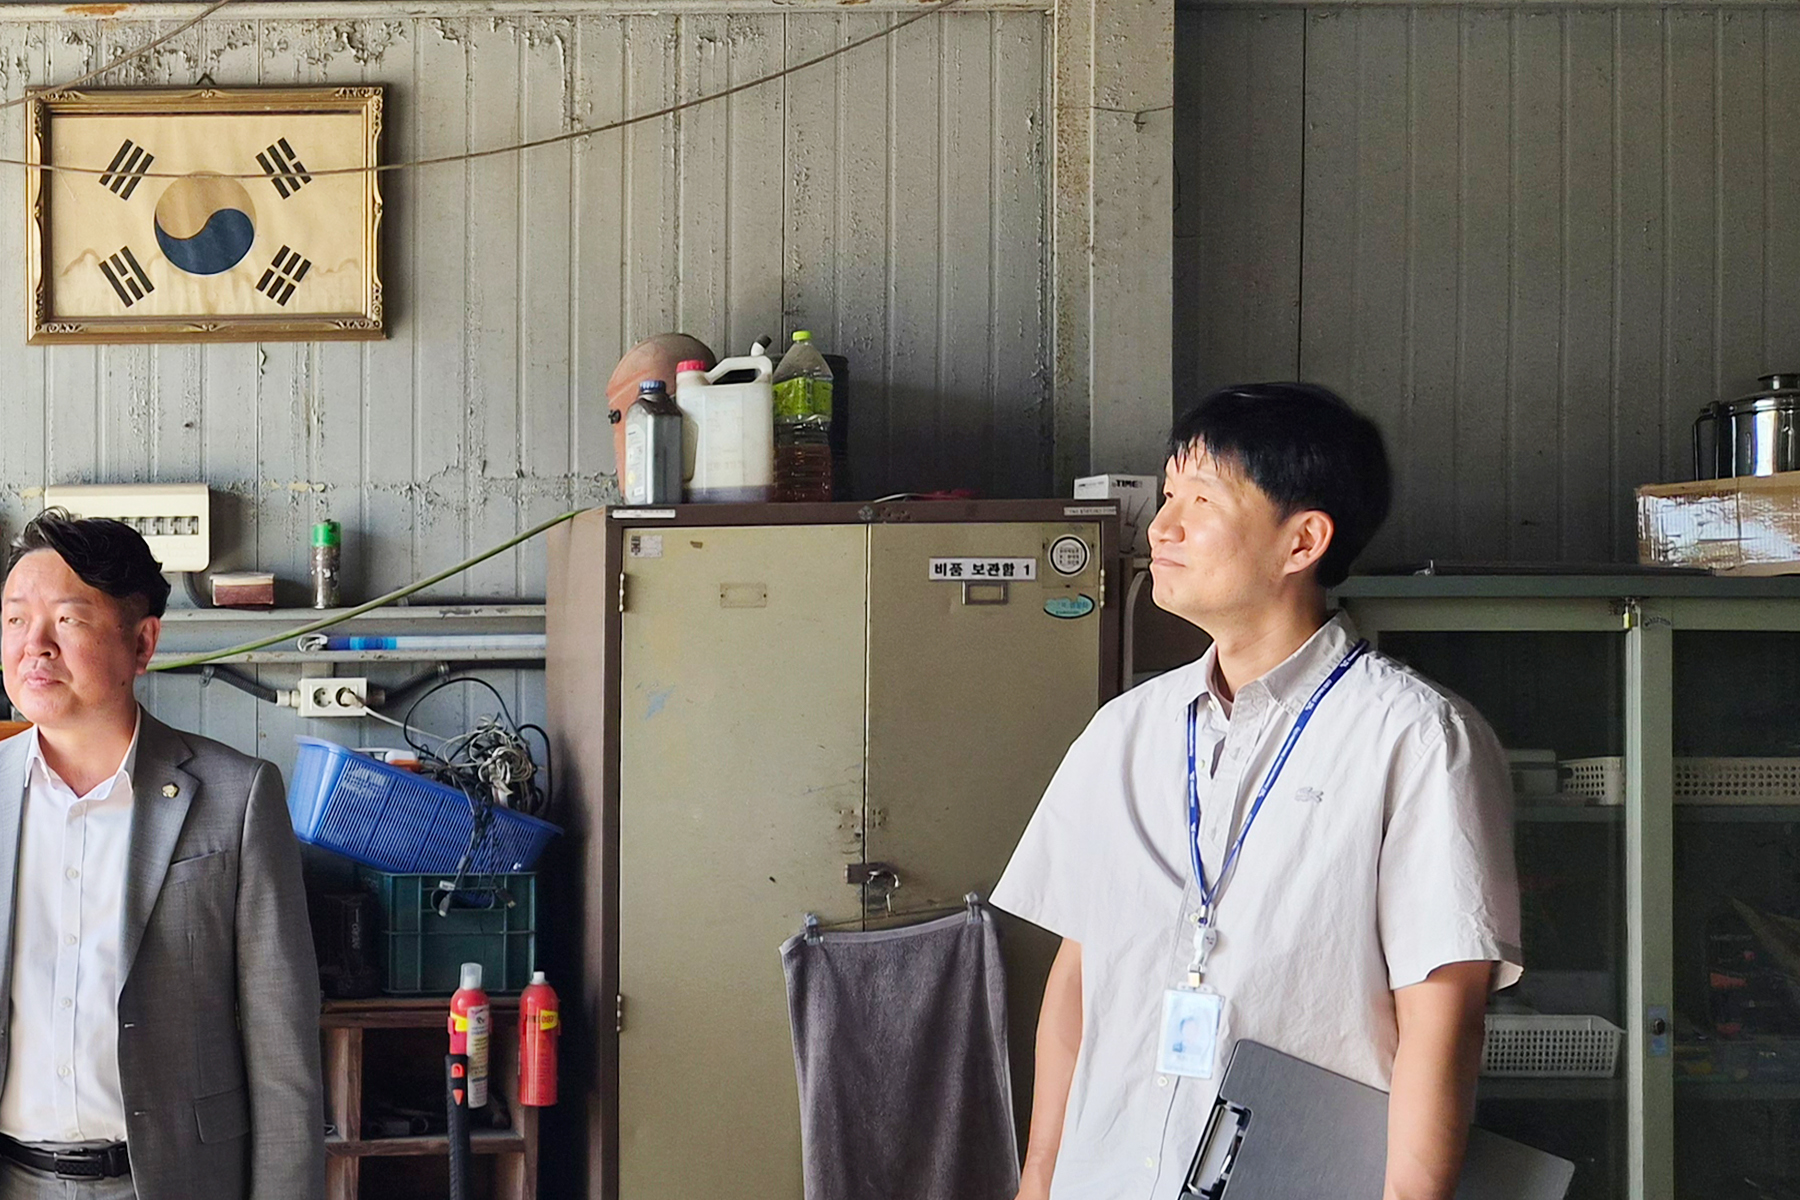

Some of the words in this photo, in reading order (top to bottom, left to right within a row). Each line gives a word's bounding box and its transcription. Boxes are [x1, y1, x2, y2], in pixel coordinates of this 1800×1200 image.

[934, 562, 963, 577] 비품
[971, 562, 1015, 577] 보관함
[1023, 563, 1030, 576] 1
